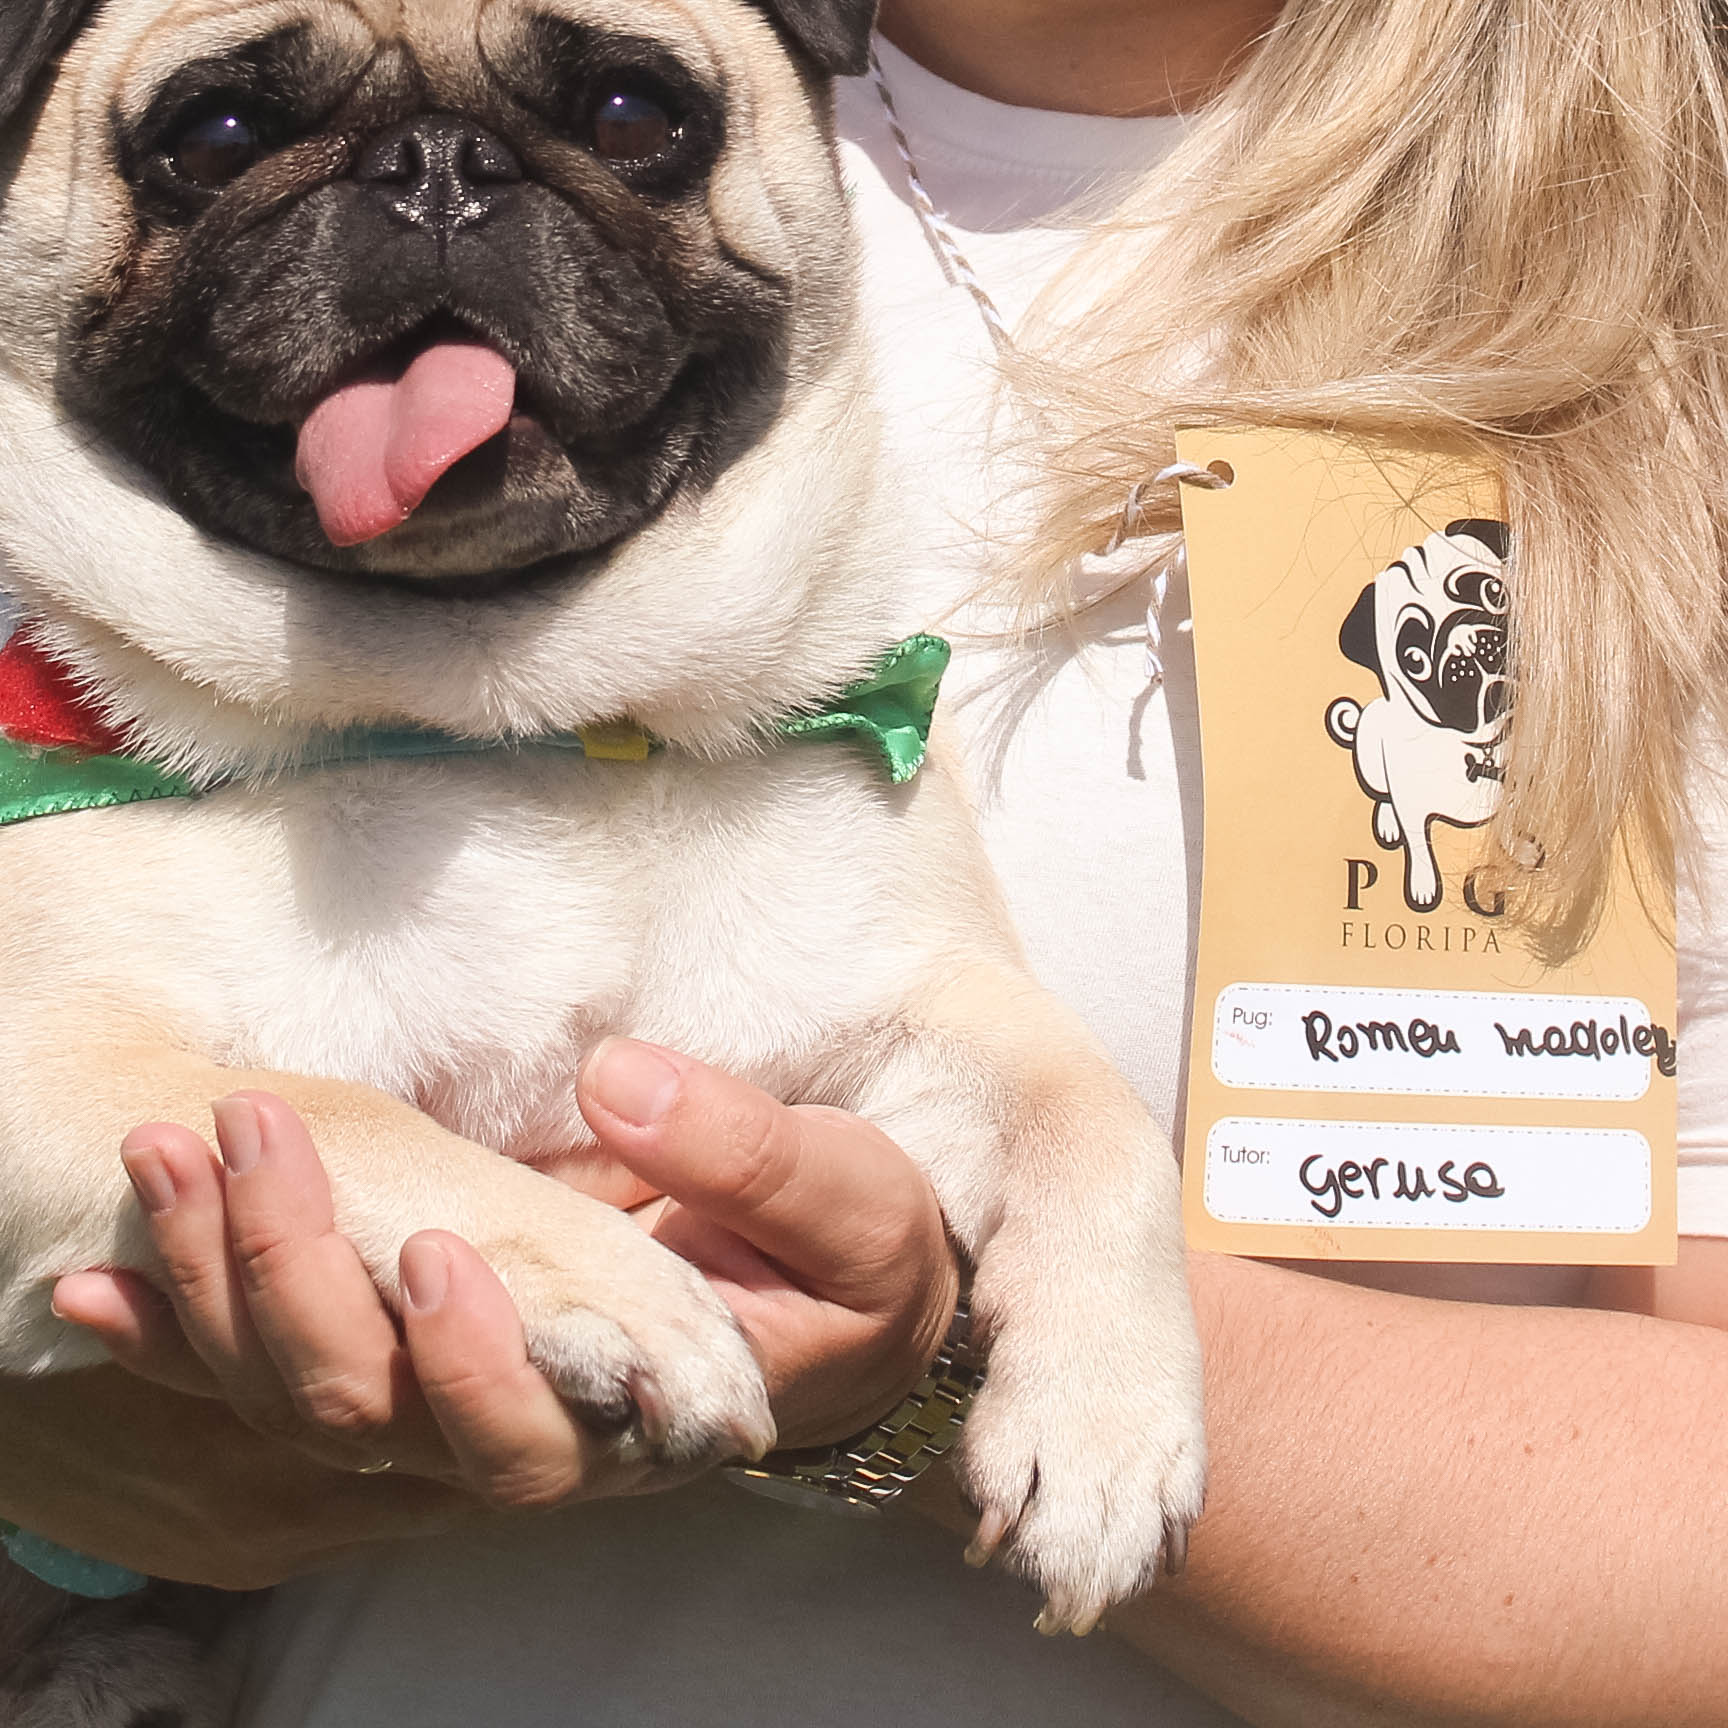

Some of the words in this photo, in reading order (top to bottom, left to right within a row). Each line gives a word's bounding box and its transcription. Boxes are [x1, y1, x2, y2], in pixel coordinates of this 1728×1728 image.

[1341, 922, 1502, 954] FLORIPA
[1232, 1007, 1273, 1030] Pug:
[1222, 1145, 1271, 1165] Tutor:
